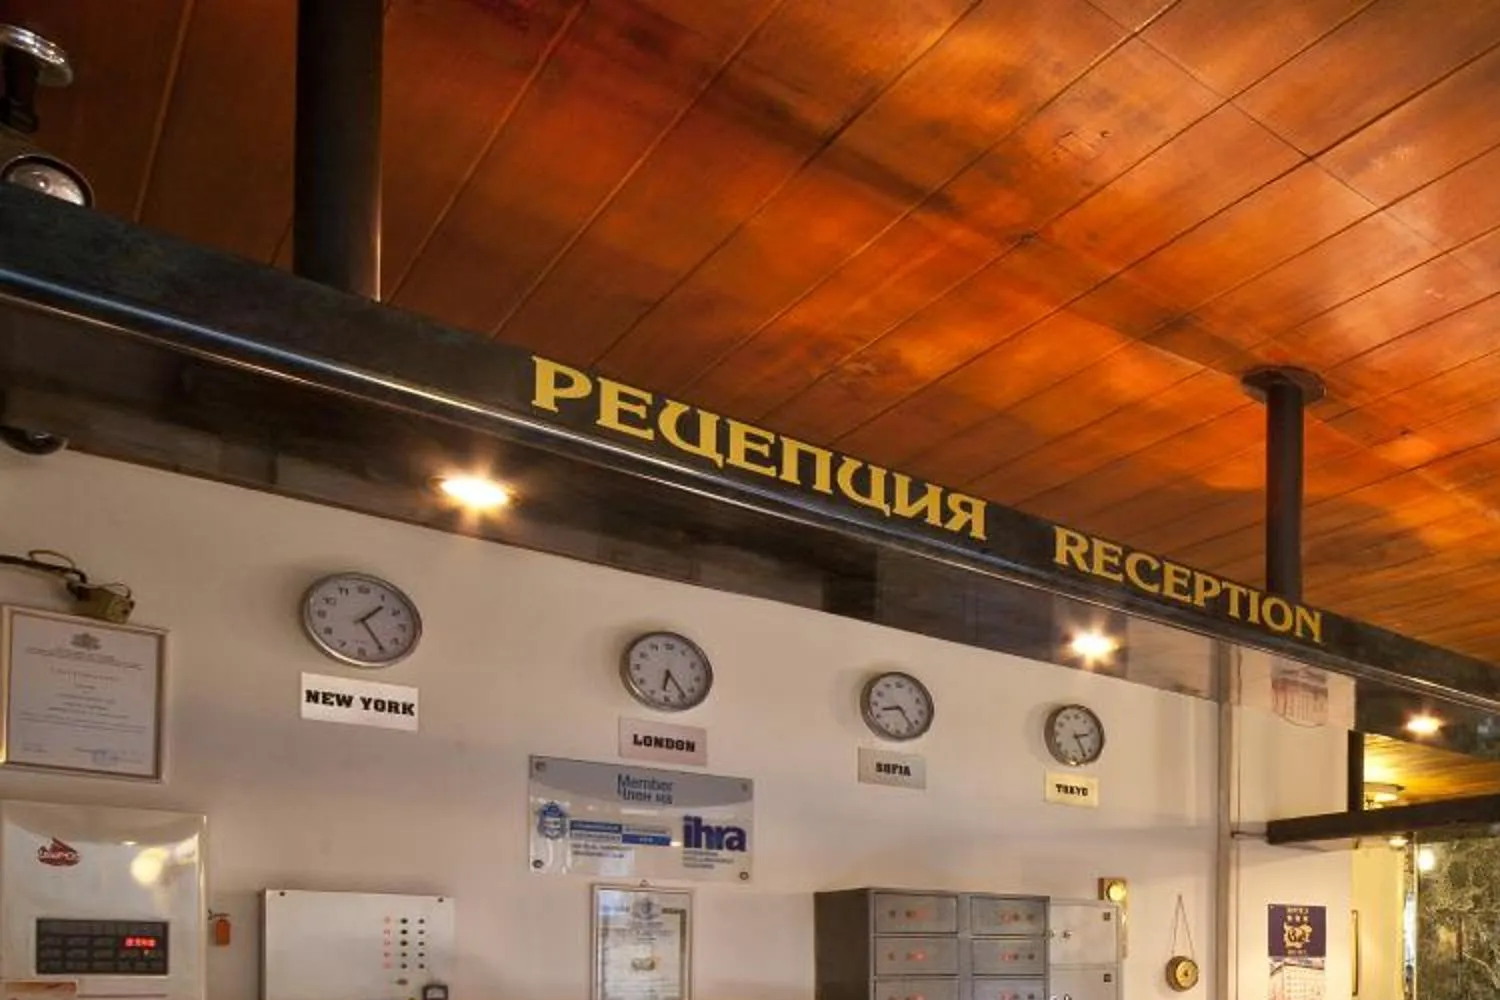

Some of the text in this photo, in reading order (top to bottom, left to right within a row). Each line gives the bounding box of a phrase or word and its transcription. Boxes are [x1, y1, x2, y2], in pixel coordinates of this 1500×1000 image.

[531, 355, 987, 541] РЕЦЕПЦИЯ
[1054, 526, 1322, 643] RECEPTION
[305, 689, 415, 716] NEW YORK
[633, 733, 695, 752] LONDON
[617, 773, 674, 792] Member
[683, 814, 747, 852] ihra
